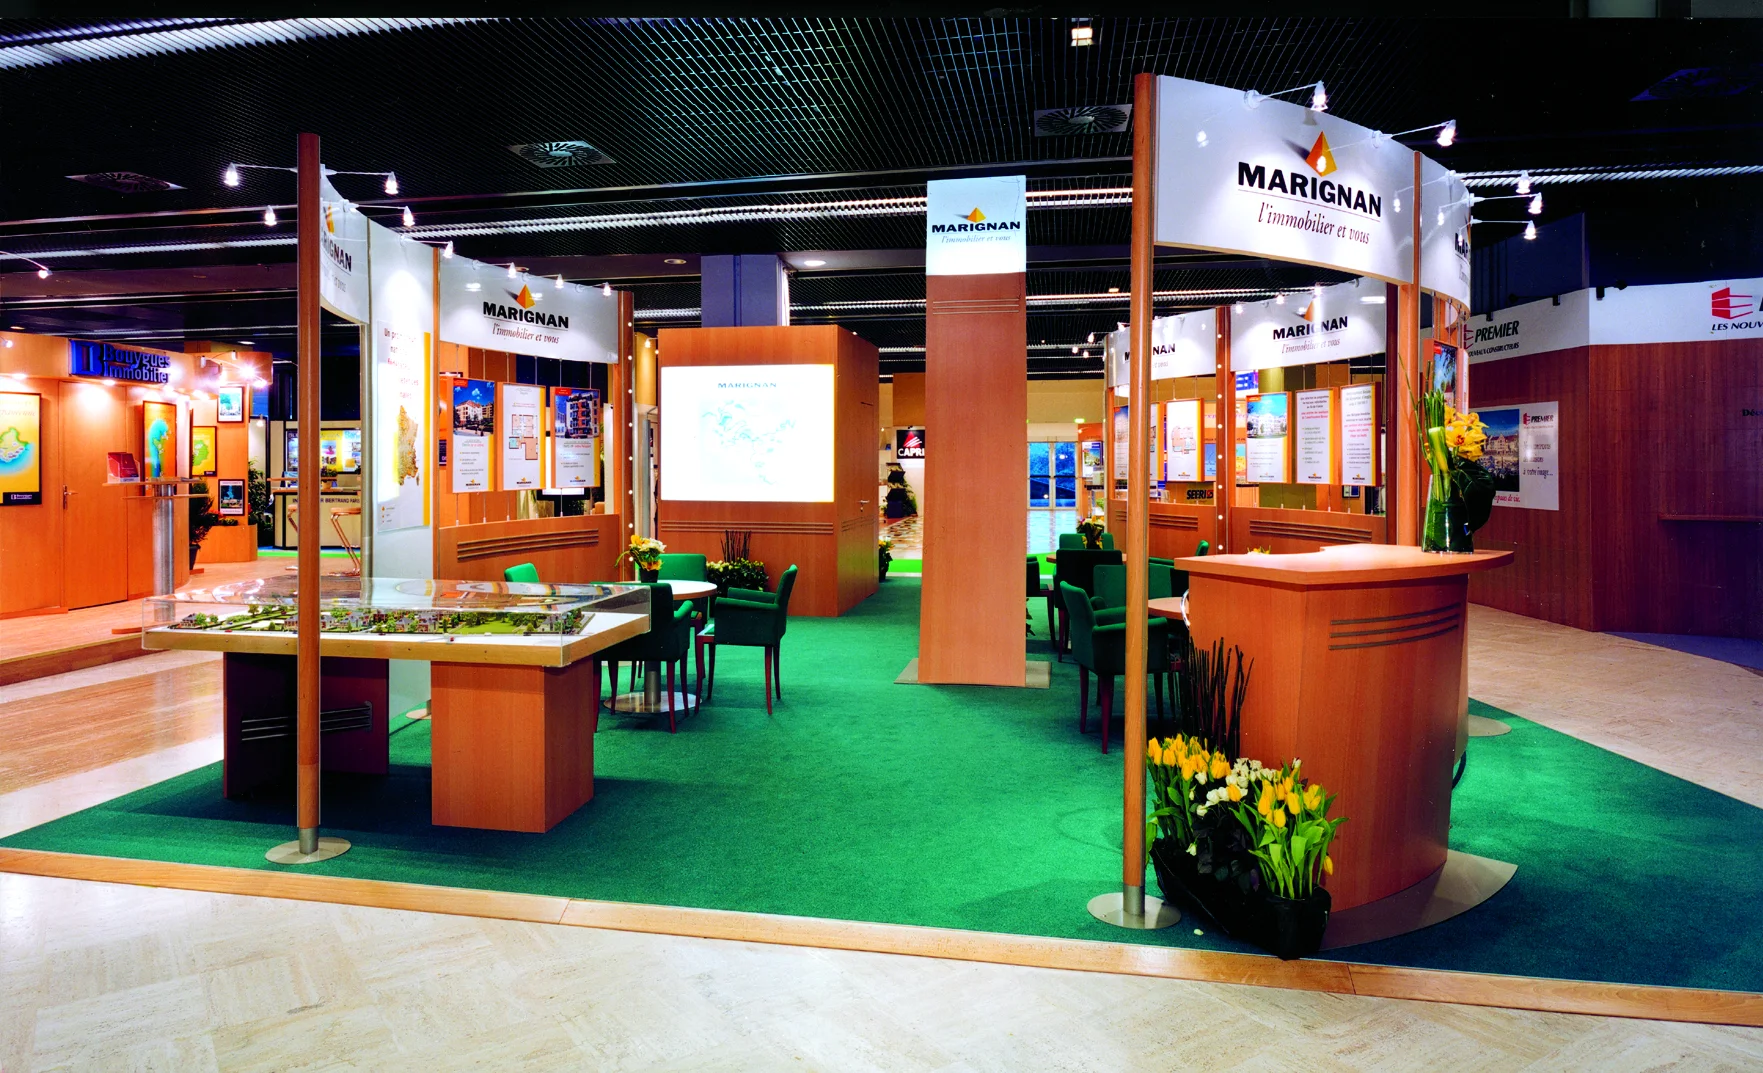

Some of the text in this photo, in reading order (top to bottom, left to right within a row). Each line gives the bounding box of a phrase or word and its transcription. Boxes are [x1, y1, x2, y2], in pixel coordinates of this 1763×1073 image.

[1238, 161, 1382, 218] MARIGNAN
[931, 221, 1021, 234] MARIGNAN
[1258, 202, 1370, 245] l'immobilier et vous
[941, 235, 985, 244] l'immobilier
[483, 301, 569, 329] MARIGNAN
[492, 322, 560, 344] l'immobilier et vous
[1474, 320, 1520, 343] PREMIER
[1712, 323, 1728, 331] LES
[103, 343, 171, 370] Bouygues
[103, 361, 172, 383] Immobilie
[1531, 415, 1553, 423] PREMIER
[897, 447, 926, 457] CAPRI
